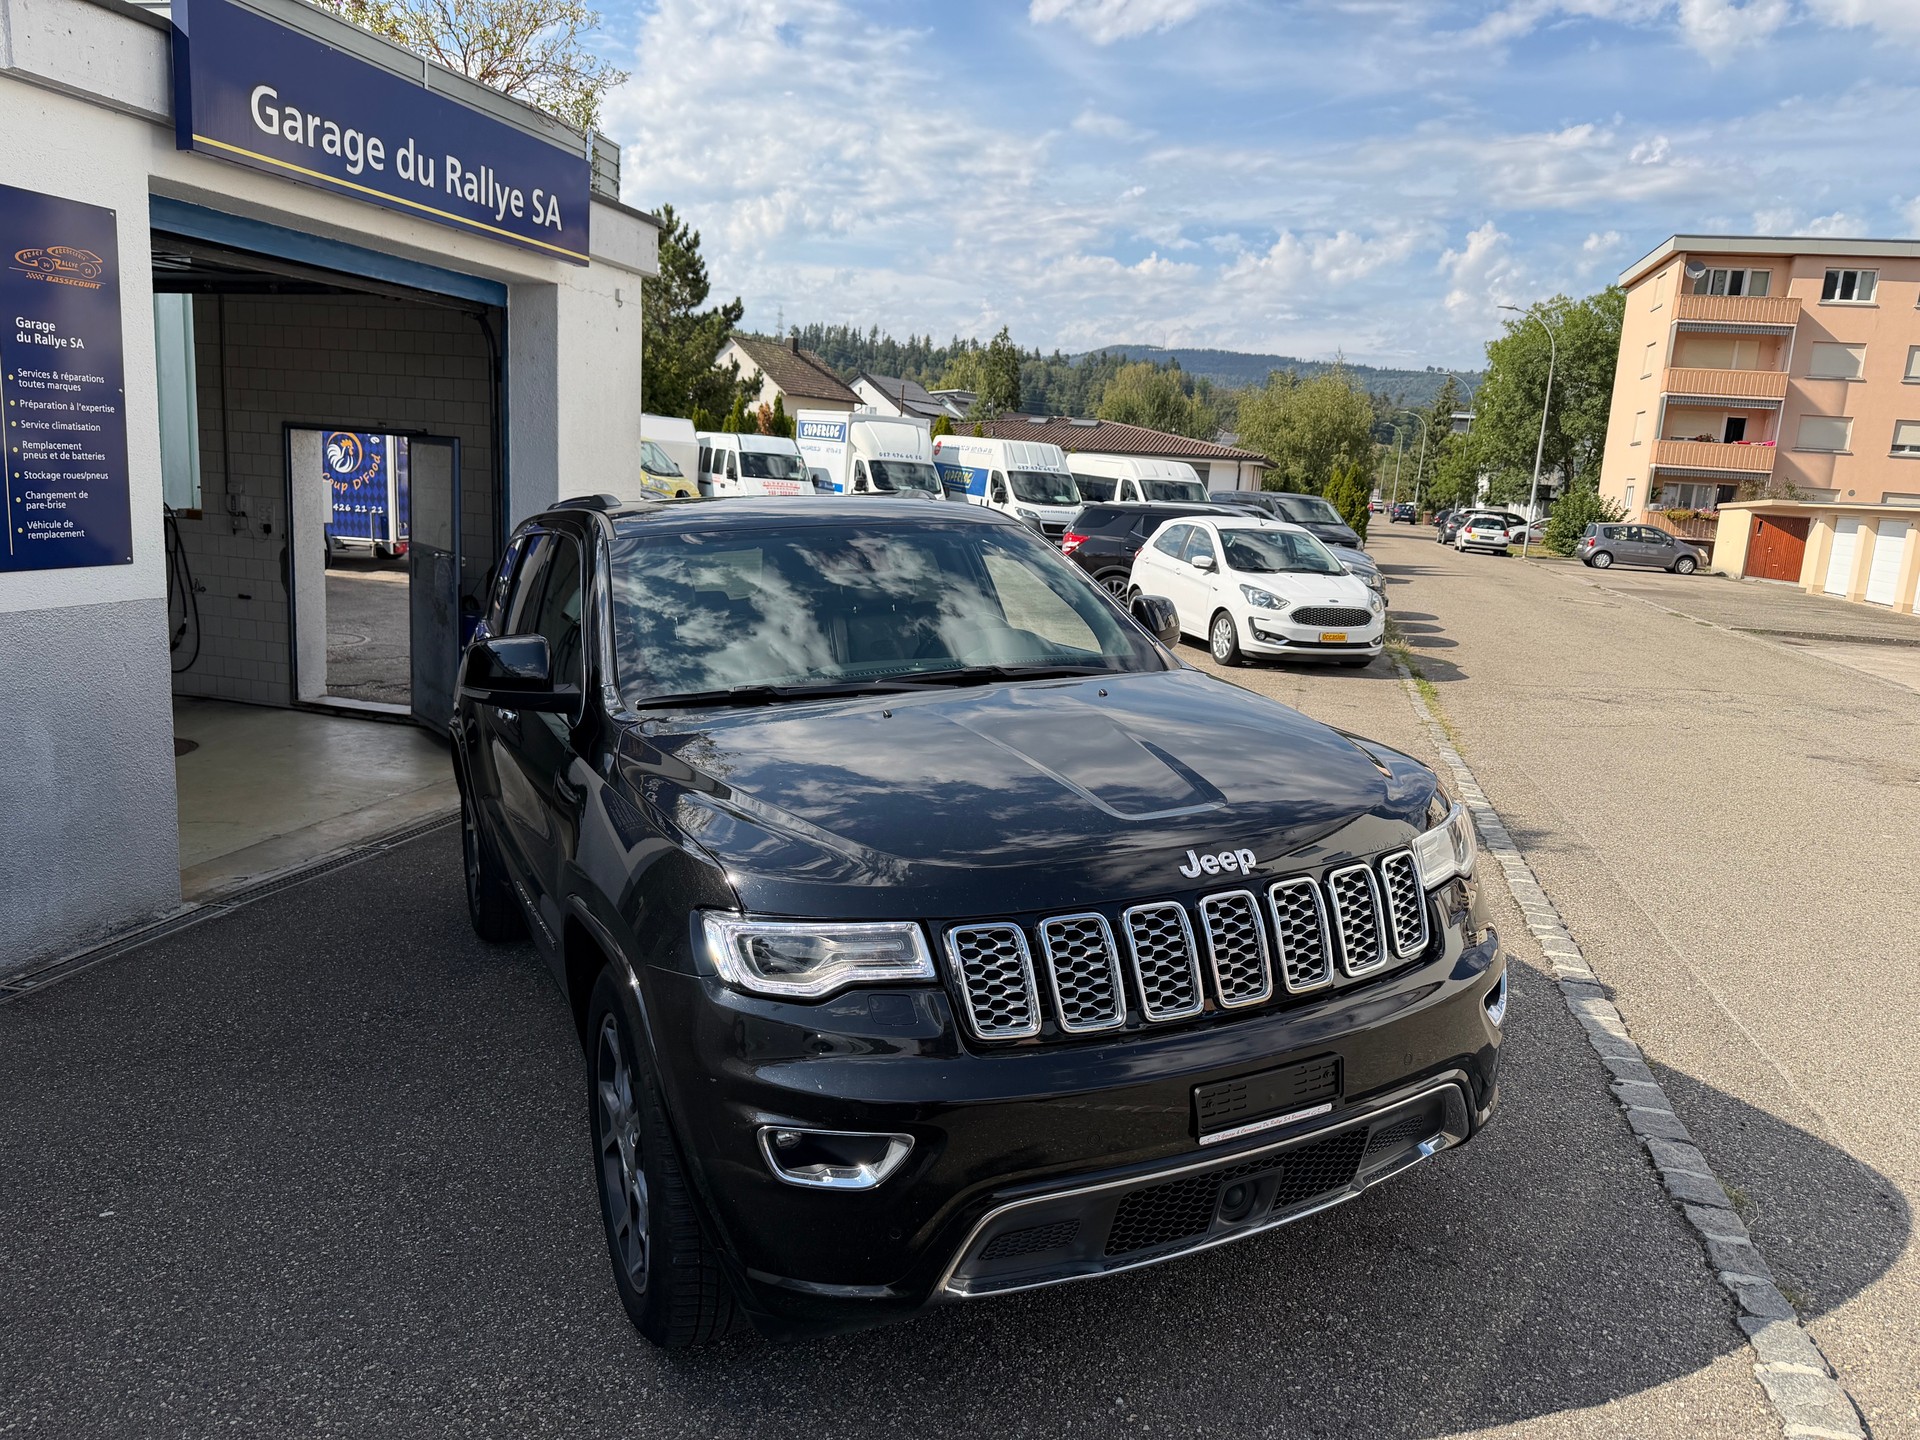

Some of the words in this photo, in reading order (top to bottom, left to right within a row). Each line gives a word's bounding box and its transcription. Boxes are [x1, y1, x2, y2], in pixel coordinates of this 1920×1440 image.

[250, 85, 385, 176] Garage
[396, 138, 435, 188] du
[446, 154, 524, 221] Rallye
[532, 188, 563, 232] SA
[46, 275, 101, 289] BASSECOURT
[15, 316, 56, 333] Garage
[16, 331, 31, 343] du
[34, 333, 67, 349] Rallye
[70, 337, 85, 349] SA
[17, 368, 51, 379] Services
[52, 371, 59, 379] &
[60, 372, 105, 384] réparations
[18, 379, 46, 389] toutes
[47, 382, 82, 392] marques
[19, 399, 68, 411] Préparation
[69, 402, 75, 411] à
[76, 403, 115, 414] l'expertise
[20, 420, 51, 430] Service
[51, 422, 101, 432] climatisation
[803, 423, 840, 438] SUPERLOG
[22, 441, 82, 452] Remplacement
[22, 452, 48, 461] pneus
[49, 452, 59, 460] et
[60, 451, 71, 460] de
[71, 451, 106, 461] batteries
[23, 471, 62, 482] Stockage
[62, 471, 109, 481] roues/pneus
[352, 453, 381, 491] D'Food
[25, 491, 78, 503] Changement
[78, 491, 89, 499] de
[26, 500, 67, 510] pare-brise
[332, 503, 351, 512] 426
[354, 504, 367, 513] 21
[371, 505, 384, 514] 21
[27, 520, 62, 530] Véhicule
[63, 519, 74, 529] de
[27, 529, 86, 541] remplacement
[1179, 848, 1257, 879] Jeep
